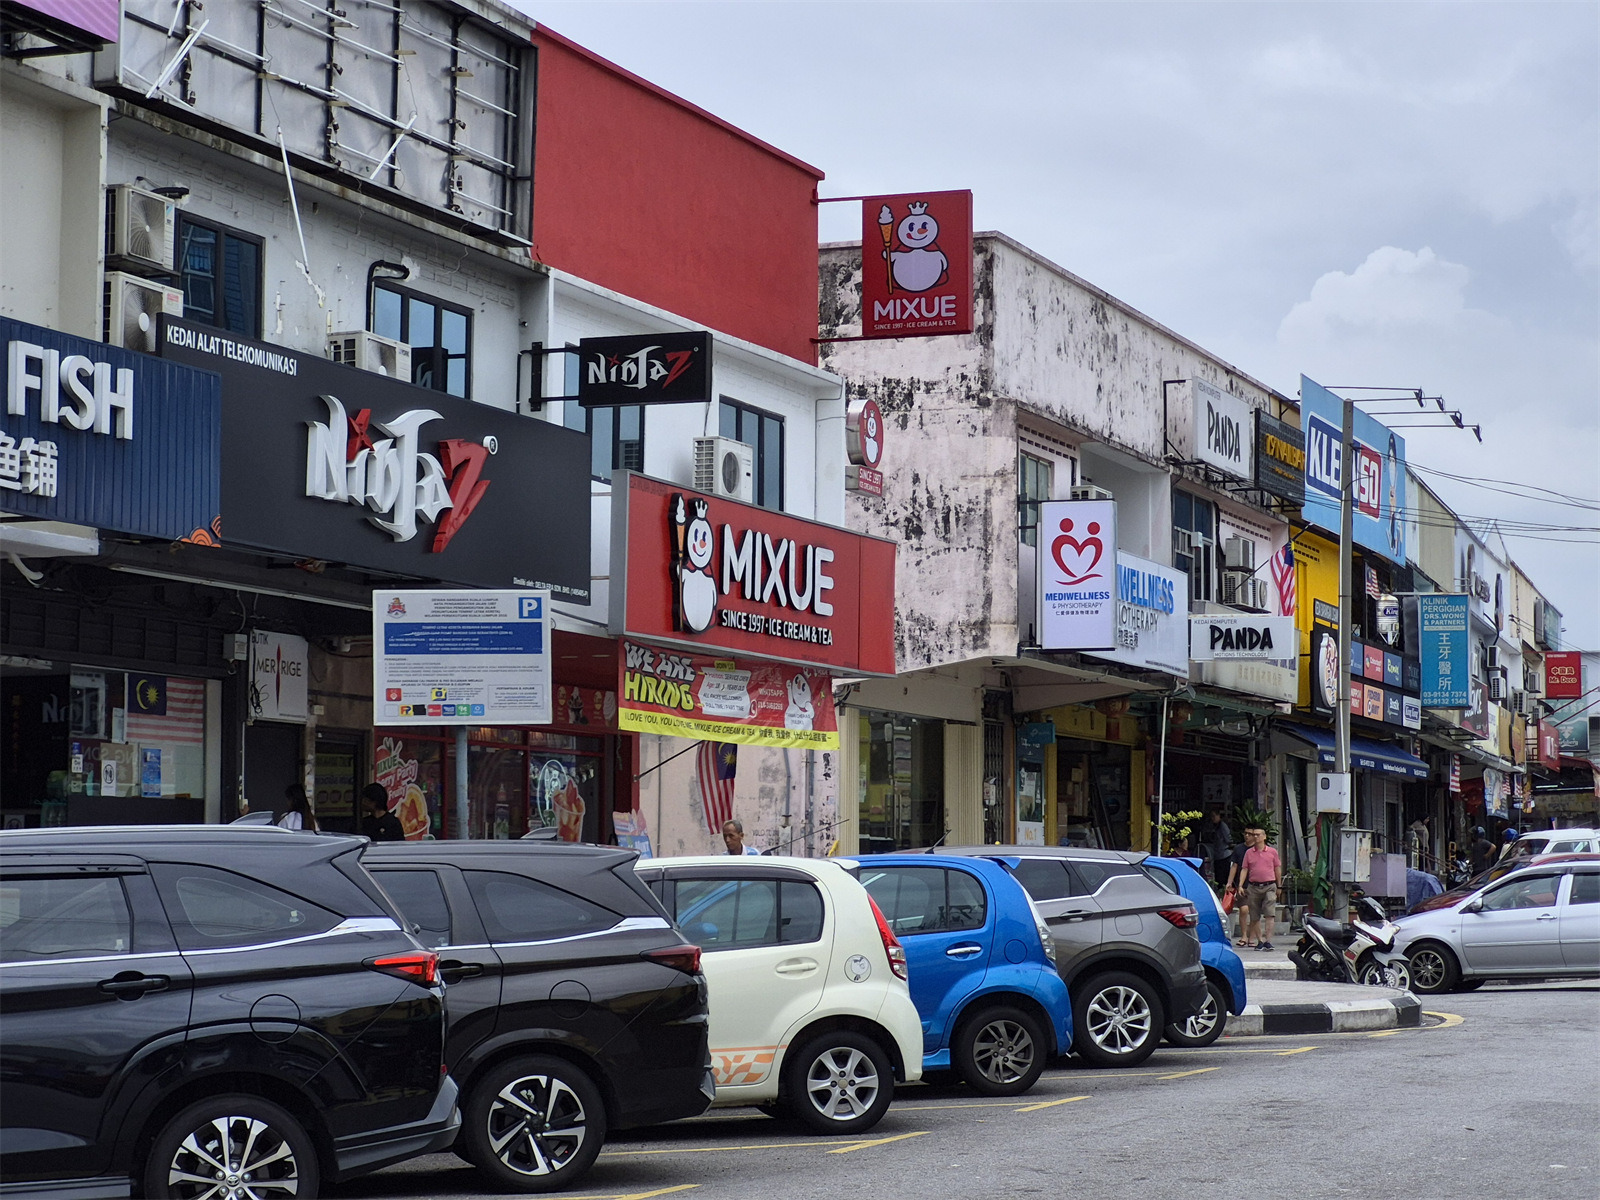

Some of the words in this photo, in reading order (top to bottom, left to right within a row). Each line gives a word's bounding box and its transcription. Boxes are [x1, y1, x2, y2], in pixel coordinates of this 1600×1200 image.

[874, 295, 956, 321] MIXUE
[917, 320, 938, 328] CREAM
[167, 324, 196, 349] KEDAI
[197, 332, 221, 355] ALAT
[221, 339, 297, 377] TELEKOMUNIKASI
[8, 340, 134, 440] FISH
[1207, 400, 1241, 463] PANDA
[722, 523, 834, 617] MIXUE
[1045, 591, 1110, 601] MEDIWELLNESS
[1118, 564, 1174, 615] WELLNESS
[1422, 597, 1448, 605] KLINIK
[522, 599, 538, 617] P
[1422, 605, 1466, 613] PERGIGIAN
[722, 609, 747, 630] SINCE
[748, 614, 765, 634] 1997
[769, 619, 782, 637] ICE
[783, 621, 810, 642] CREAM
[818, 628, 833, 646] TEA
[1209, 624, 1273, 651] PANDA
[624, 641, 655, 674] WE
[656, 653, 696, 682] ARE
[624, 671, 694, 711] HIRING
[1560, 676, 1578, 684] Deco
[377, 755, 397, 773] IXUE
